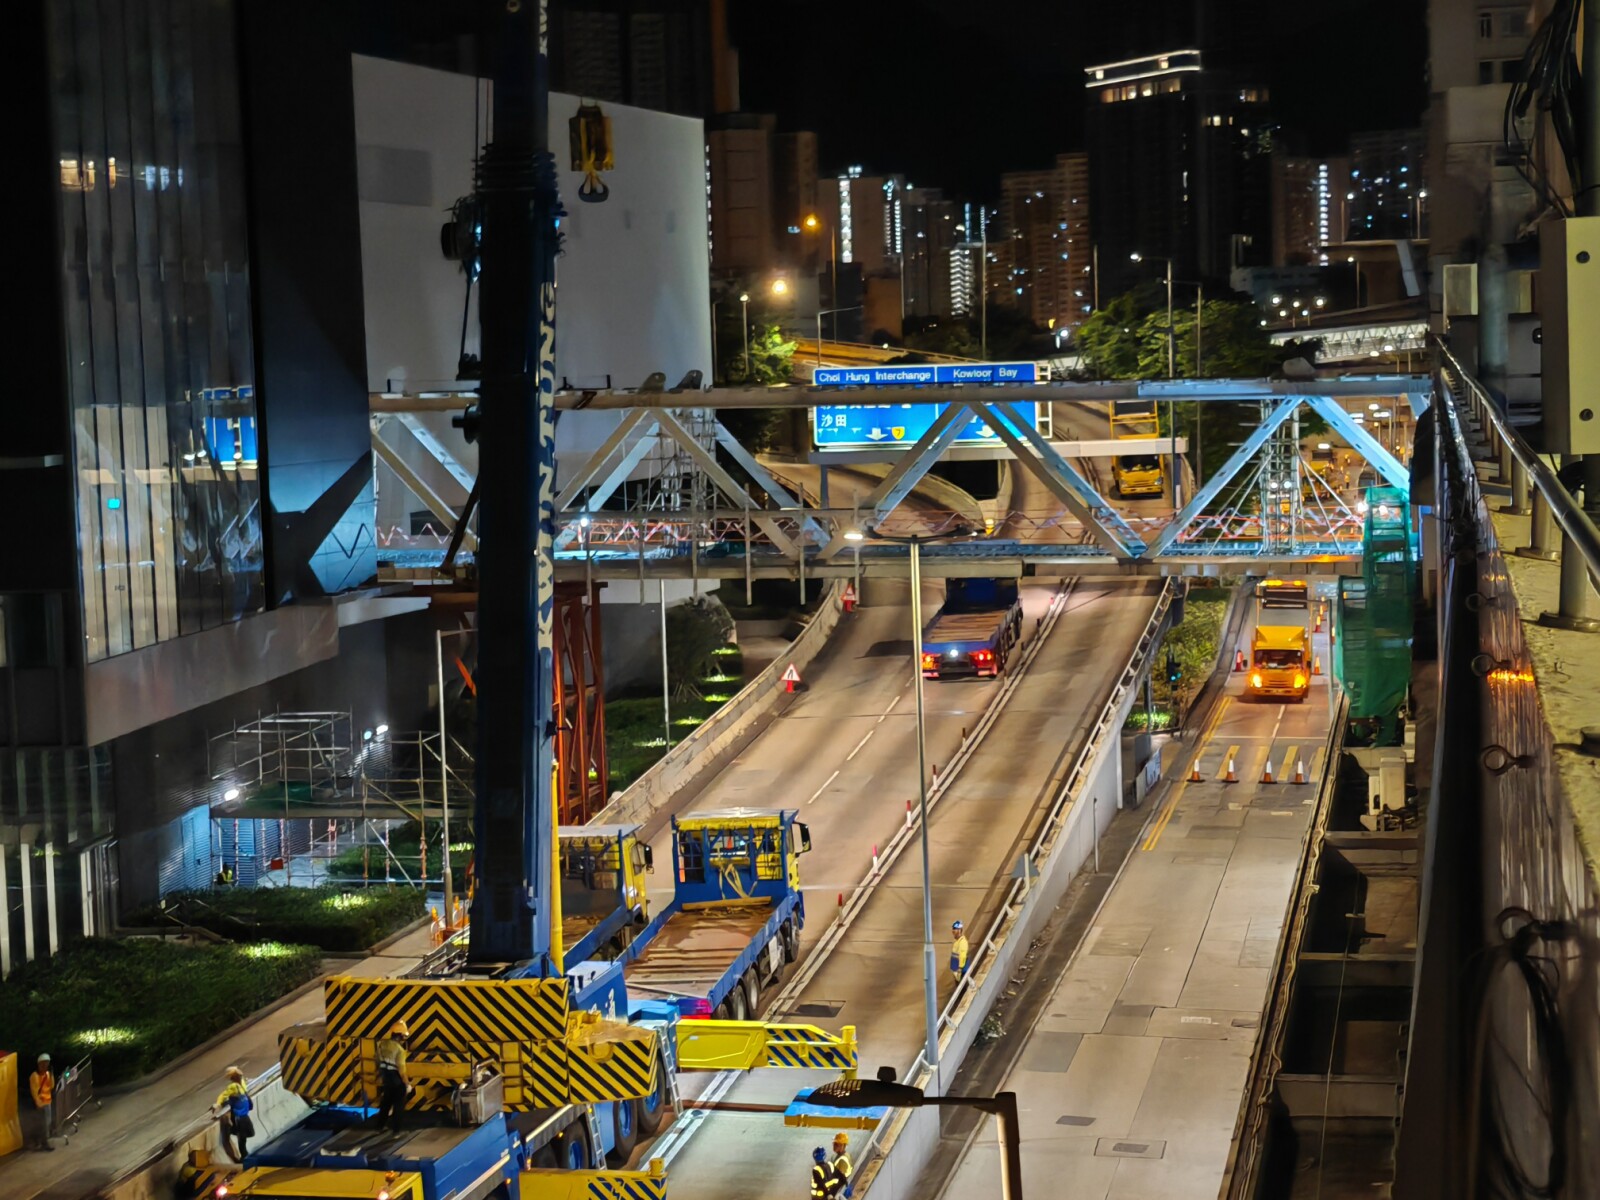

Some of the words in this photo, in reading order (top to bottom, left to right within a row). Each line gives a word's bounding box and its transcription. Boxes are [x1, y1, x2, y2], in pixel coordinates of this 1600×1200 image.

[538, 282, 555, 448] TUNG
[819, 372, 840, 382] Choi
[846, 372, 870, 383] Hung
[875, 371, 931, 382] Interchange
[999, 367, 1018, 378] Bay
[821, 414, 847, 428] 沙田
